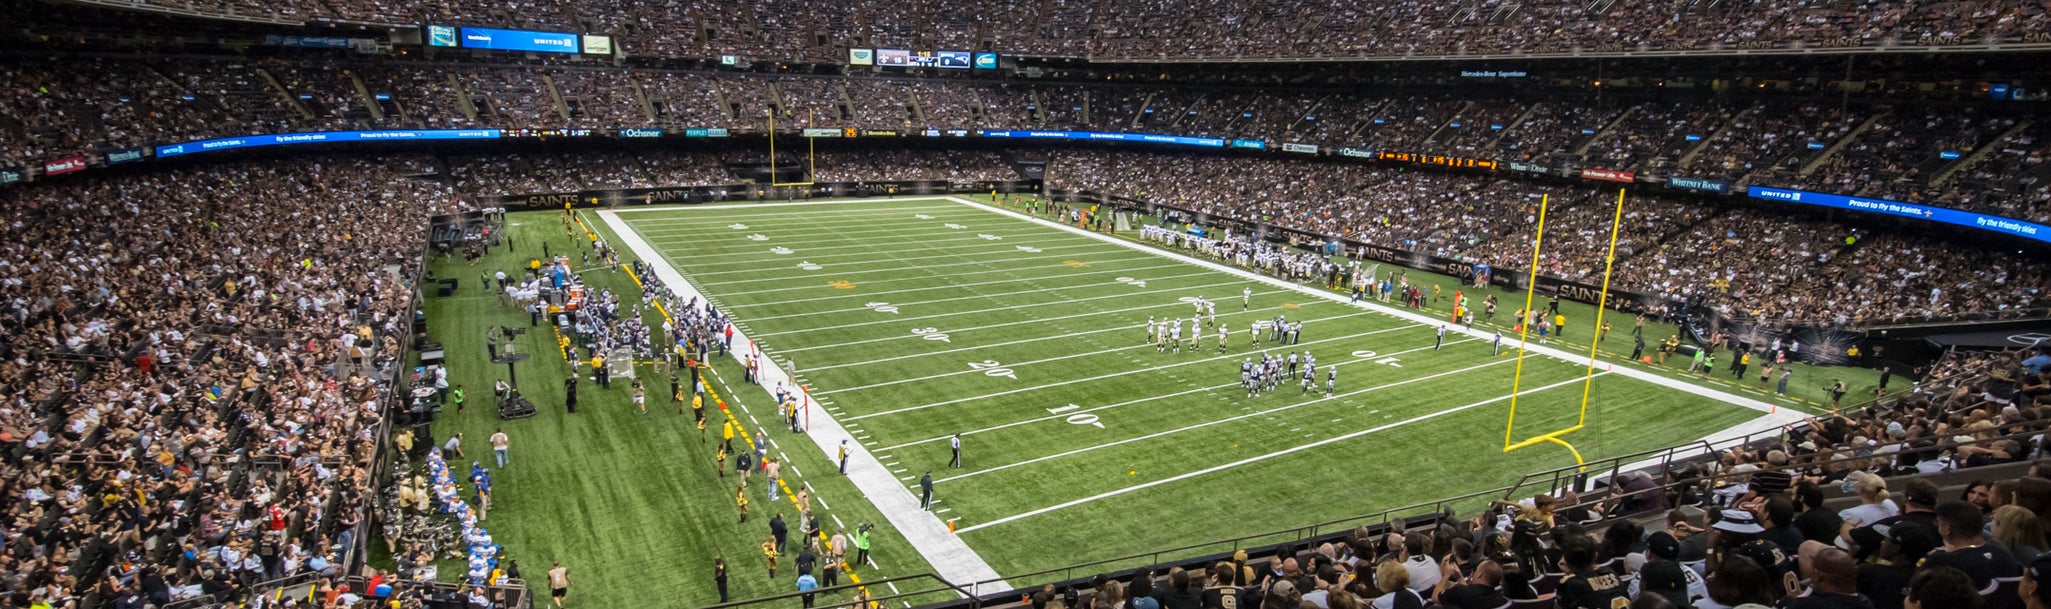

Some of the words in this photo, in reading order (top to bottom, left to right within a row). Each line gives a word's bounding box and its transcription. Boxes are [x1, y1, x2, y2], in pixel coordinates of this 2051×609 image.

[534, 38, 563, 46] UNITED
[1738, 41, 1773, 49] SAINTS
[1823, 39, 1862, 48] SAINTS
[1918, 36, 1962, 46] SAINTS
[626, 128, 660, 137] Ochsner
[1343, 147, 1371, 158] Ochsner
[869, 184, 900, 193] AINTS
[1672, 178, 1702, 188] WHITNEY
[1702, 181, 1721, 190] BANK
[529, 194, 579, 207] SAINTS
[1761, 190, 1792, 199] UNITED
[1848, 199, 1870, 208] Proud
[1878, 203, 1889, 211] fly
[1889, 204, 1900, 212] the
[1977, 216, 1987, 226] fly
[1986, 219, 1998, 227] the
[1998, 220, 2022, 232] friendly
[2021, 225, 2037, 235] skies
[1364, 246, 1394, 262] AINTS
[1560, 284, 1614, 305] SAINTS
[911, 327, 949, 341] 30
[967, 359, 1014, 377] 20
[1046, 403, 1099, 425] 10
